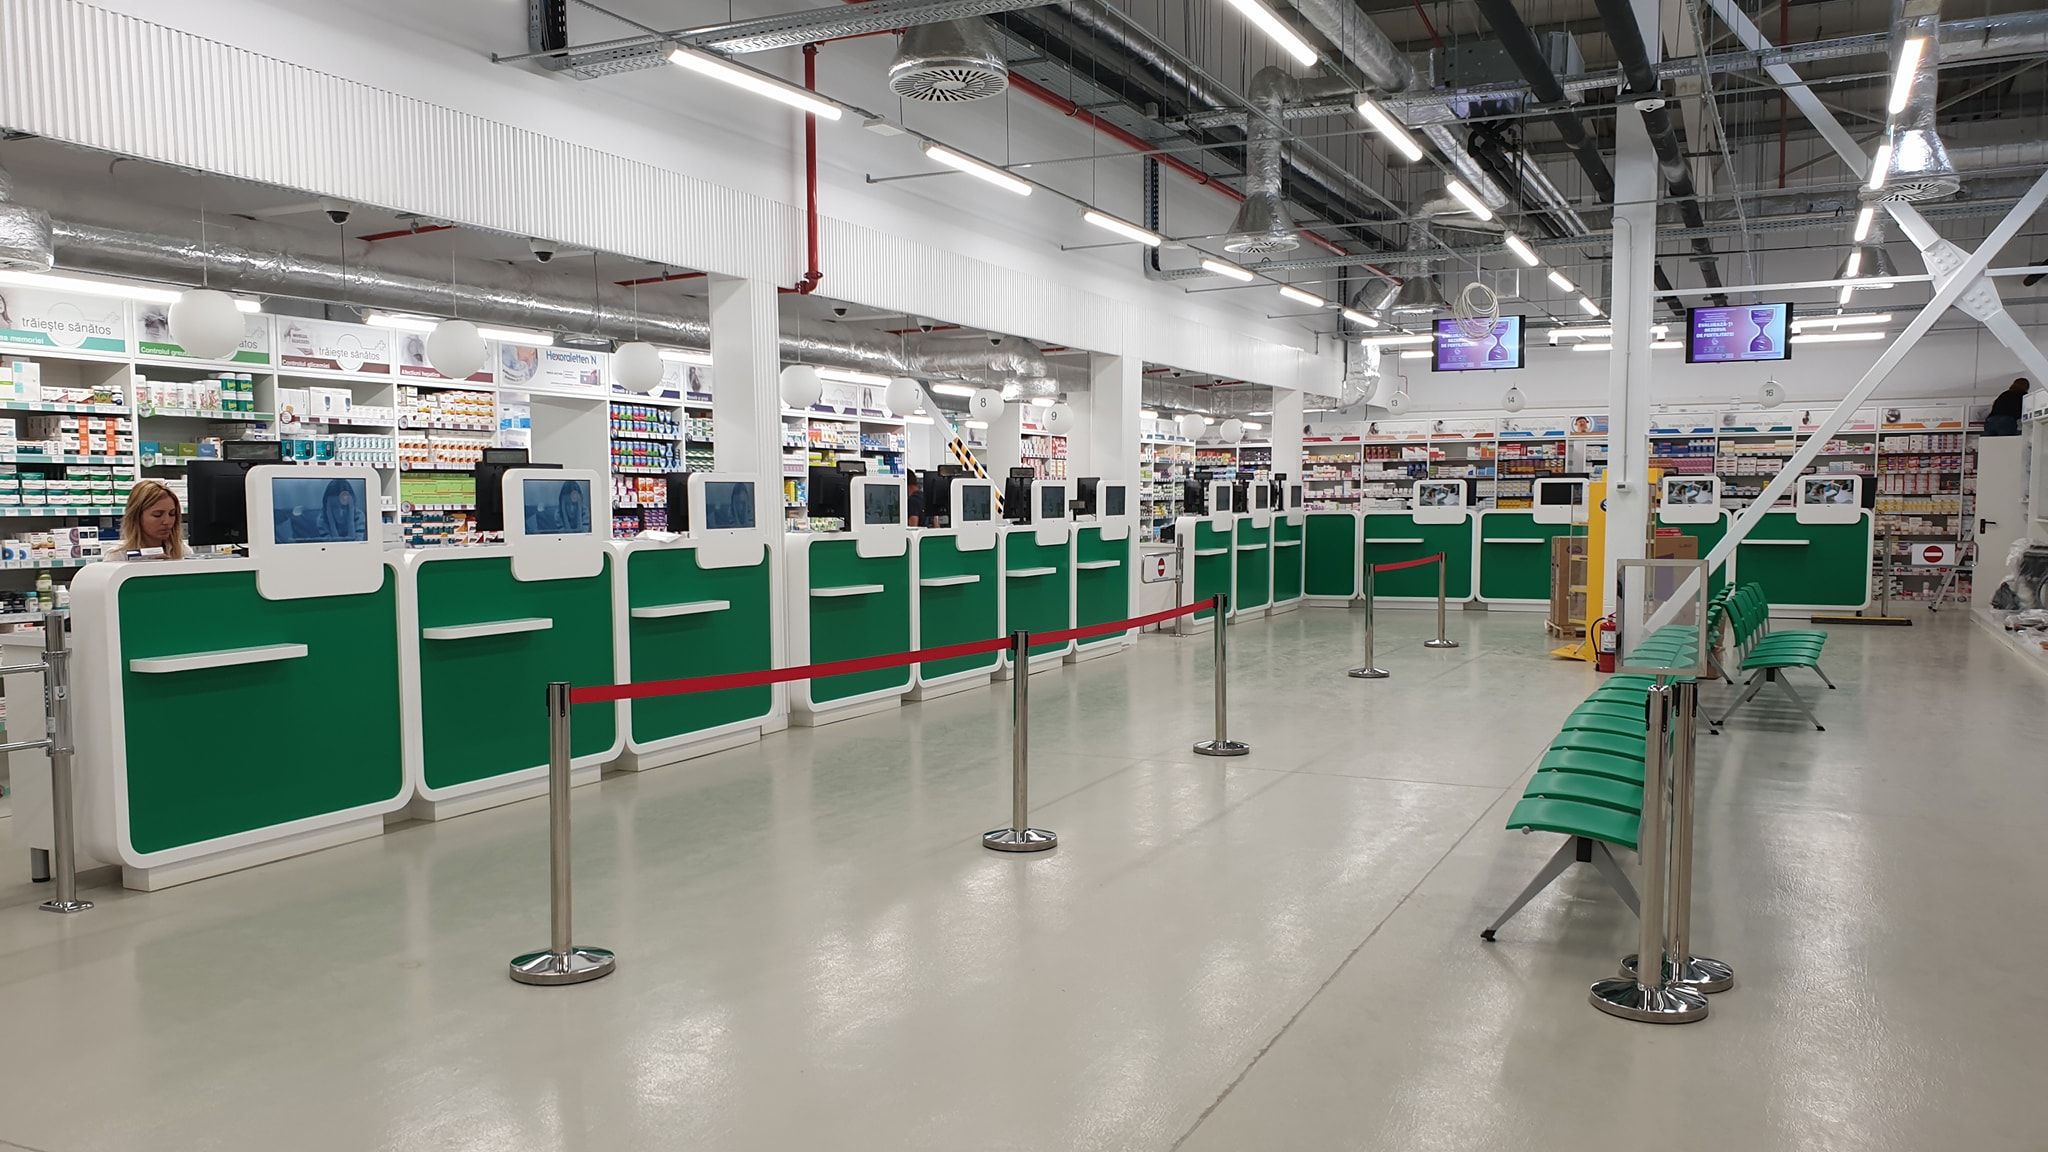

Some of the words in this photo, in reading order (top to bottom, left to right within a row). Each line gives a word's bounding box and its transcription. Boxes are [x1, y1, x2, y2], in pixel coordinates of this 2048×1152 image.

[22, 317, 65, 332] trăiește
[68, 322, 112, 335] sănătos
[546, 350, 590, 364] Hexoraletten
[590, 356, 597, 365] N
[914, 388, 920, 400] 7
[1765, 389, 1774, 397] 16
[979, 396, 987, 409] 8
[1051, 411, 1058, 421] 9
